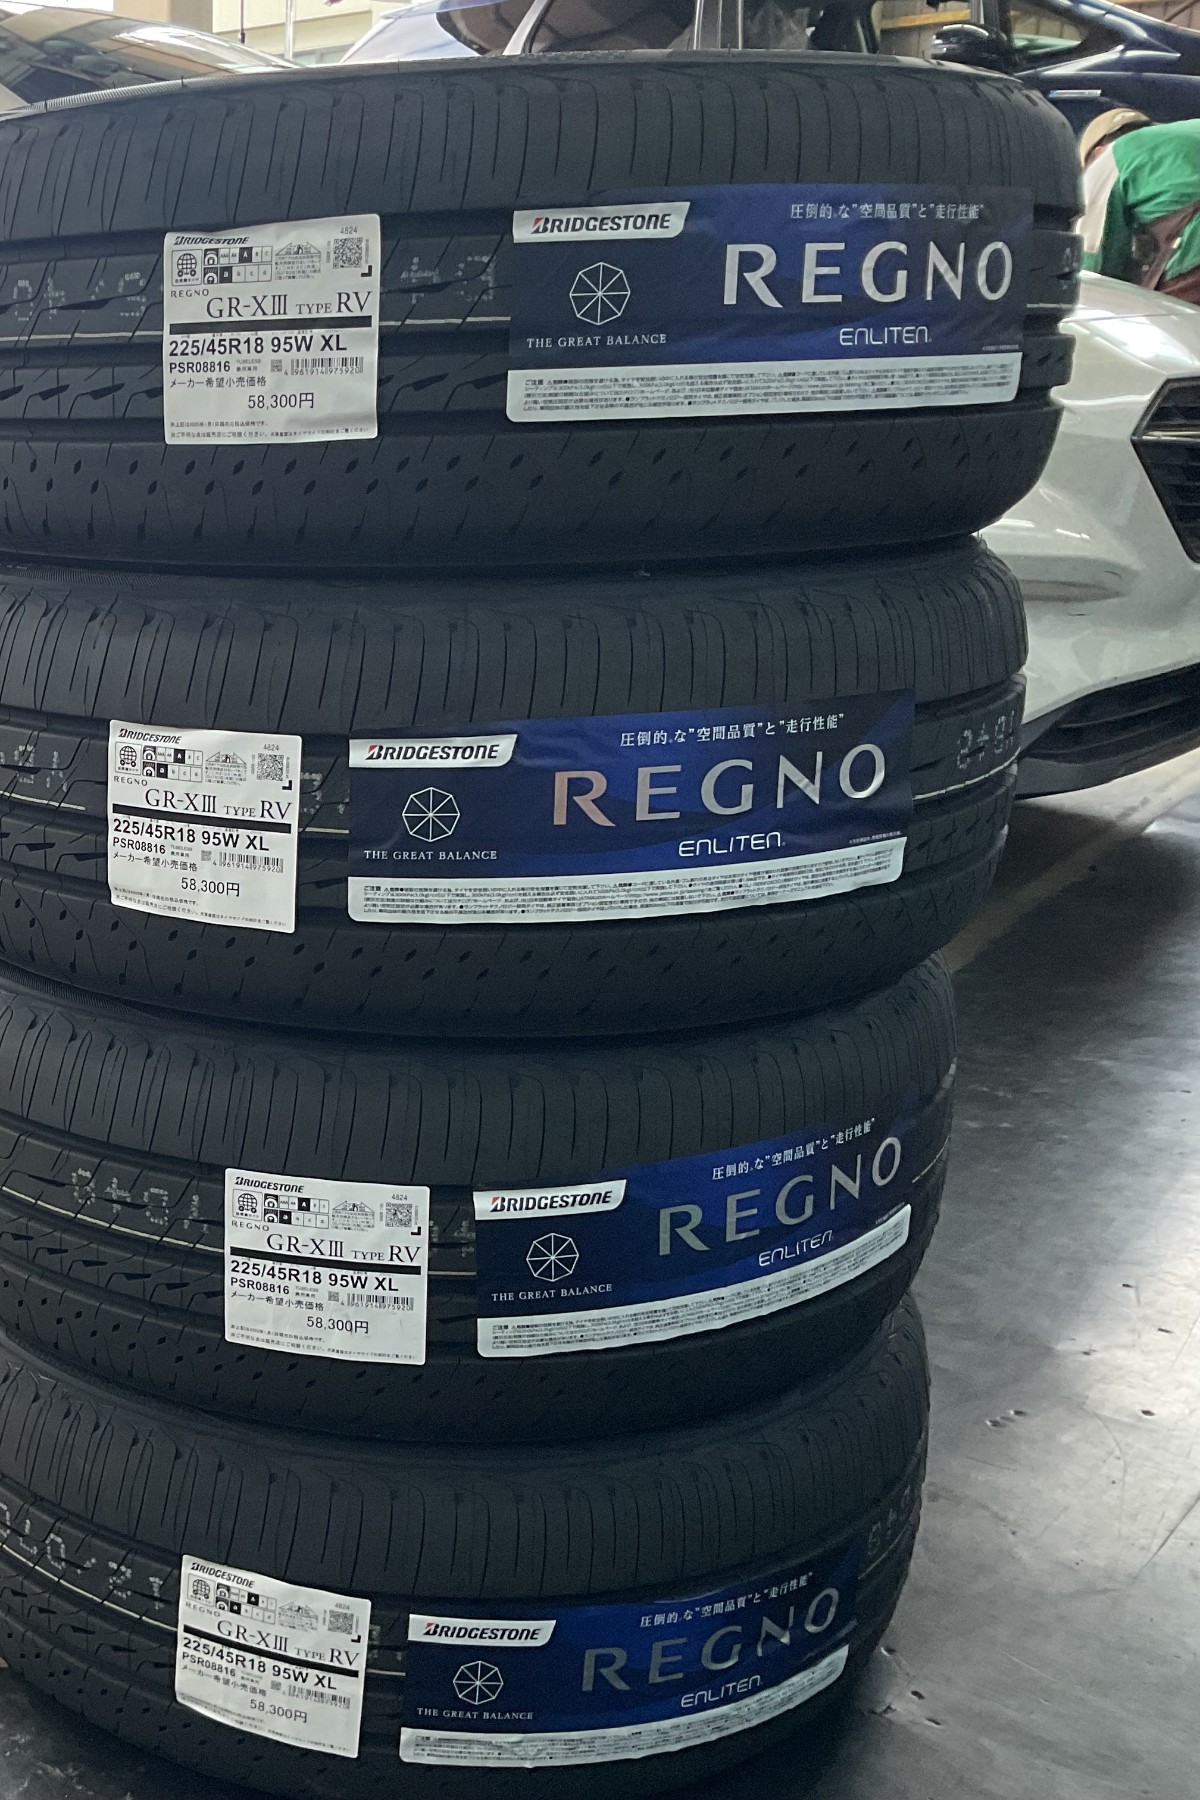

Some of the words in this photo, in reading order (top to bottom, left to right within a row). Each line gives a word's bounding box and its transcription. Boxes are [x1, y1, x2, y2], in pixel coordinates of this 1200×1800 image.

[340, 226, 357, 234] 4824
[530, 213, 670, 235] BRIDGESTONE
[173, 236, 249, 245] BRIDGESTONE
[724, 240, 1013, 308] REGNO
[171, 289, 209, 298] REGNO
[296, 304, 332, 314] TYPE
[337, 291, 372, 312] RV
[169, 337, 264, 356] 225/45R18
[271, 336, 313, 353] 95W
[320, 335, 347, 351] XL
[527, 337, 554, 348] THE
[558, 335, 603, 348] GREAT
[606, 334, 667, 347] BALANCE
[840, 327, 929, 346] ENLITEN
[170, 361, 230, 373] PSR08816
[170, 376, 266, 388] メーカー希望小売価格
[248, 393, 314, 410] 58,300円
[118, 729, 182, 744] BRIDGESTONE
[365, 744, 498, 762] BRIDGESTONE
[114, 777, 147, 787] REGNO
[553, 744, 885, 826] REGNO
[224, 805, 256, 817] TYPE
[261, 801, 293, 819] RV
[114, 819, 195, 843] 225/45R18
[202, 831, 239, 848] 95W
[246, 836, 269, 851] XL
[113, 837, 165, 854] PSR08816
[364, 849, 388, 860] THE
[393, 849, 433, 860] GREAT
[438, 850, 497, 860] BALANCE
[678, 833, 782, 857] ENLITEN
[113, 853, 197, 871] メーカー希望小売価格
[181, 877, 240, 897] 58,300円
[235, 1177, 304, 1193] BRIDGESTONE
[490, 1189, 611, 1212] BRIDGESTONE
[658, 1136, 902, 1256] REGNO
[232, 1221, 269, 1231] REGNO
[351, 1251, 385, 1261] TYPE
[389, 1246, 421, 1263] RV
[758, 1229, 833, 1267] ENLITEN
[231, 1260, 321, 1284] 225/45R18
[329, 1274, 368, 1289] 95W
[374, 1277, 398, 1292] XL
[231, 1277, 290, 1294] PSR08816
[230, 1291, 324, 1311] メーカー希望小売価格
[492, 1293, 516, 1302] THE
[519, 1290, 557, 1301] GREAT
[561, 1284, 612, 1298] BALANCE
[307, 1316, 369, 1334] 58,300円
[190, 1562, 255, 1588] BRIDGESTONE
[186, 1602, 220, 1617] REGNO
[423, 1622, 540, 1641] BRIDGESTONE
[581, 1587, 839, 1692] REGNO
[182, 1653, 235, 1677] PSR08816
[183, 1637, 266, 1673] 225/45R18
[272, 1665, 308, 1683] 95W
[314, 1675, 336, 1690] XL
[295, 1648, 325, 1661] TYPE
[330, 1648, 359, 1667] RV
[181, 1665, 267, 1696] メーカー希望小売価格
[680, 1675, 762, 1708] ENLITEN
[250, 1699, 307, 1723] 58,300円
[417, 1708, 437, 1717] THE
[441, 1710, 479, 1719] GREAT
[483, 1711, 533, 1721] BALANCE
